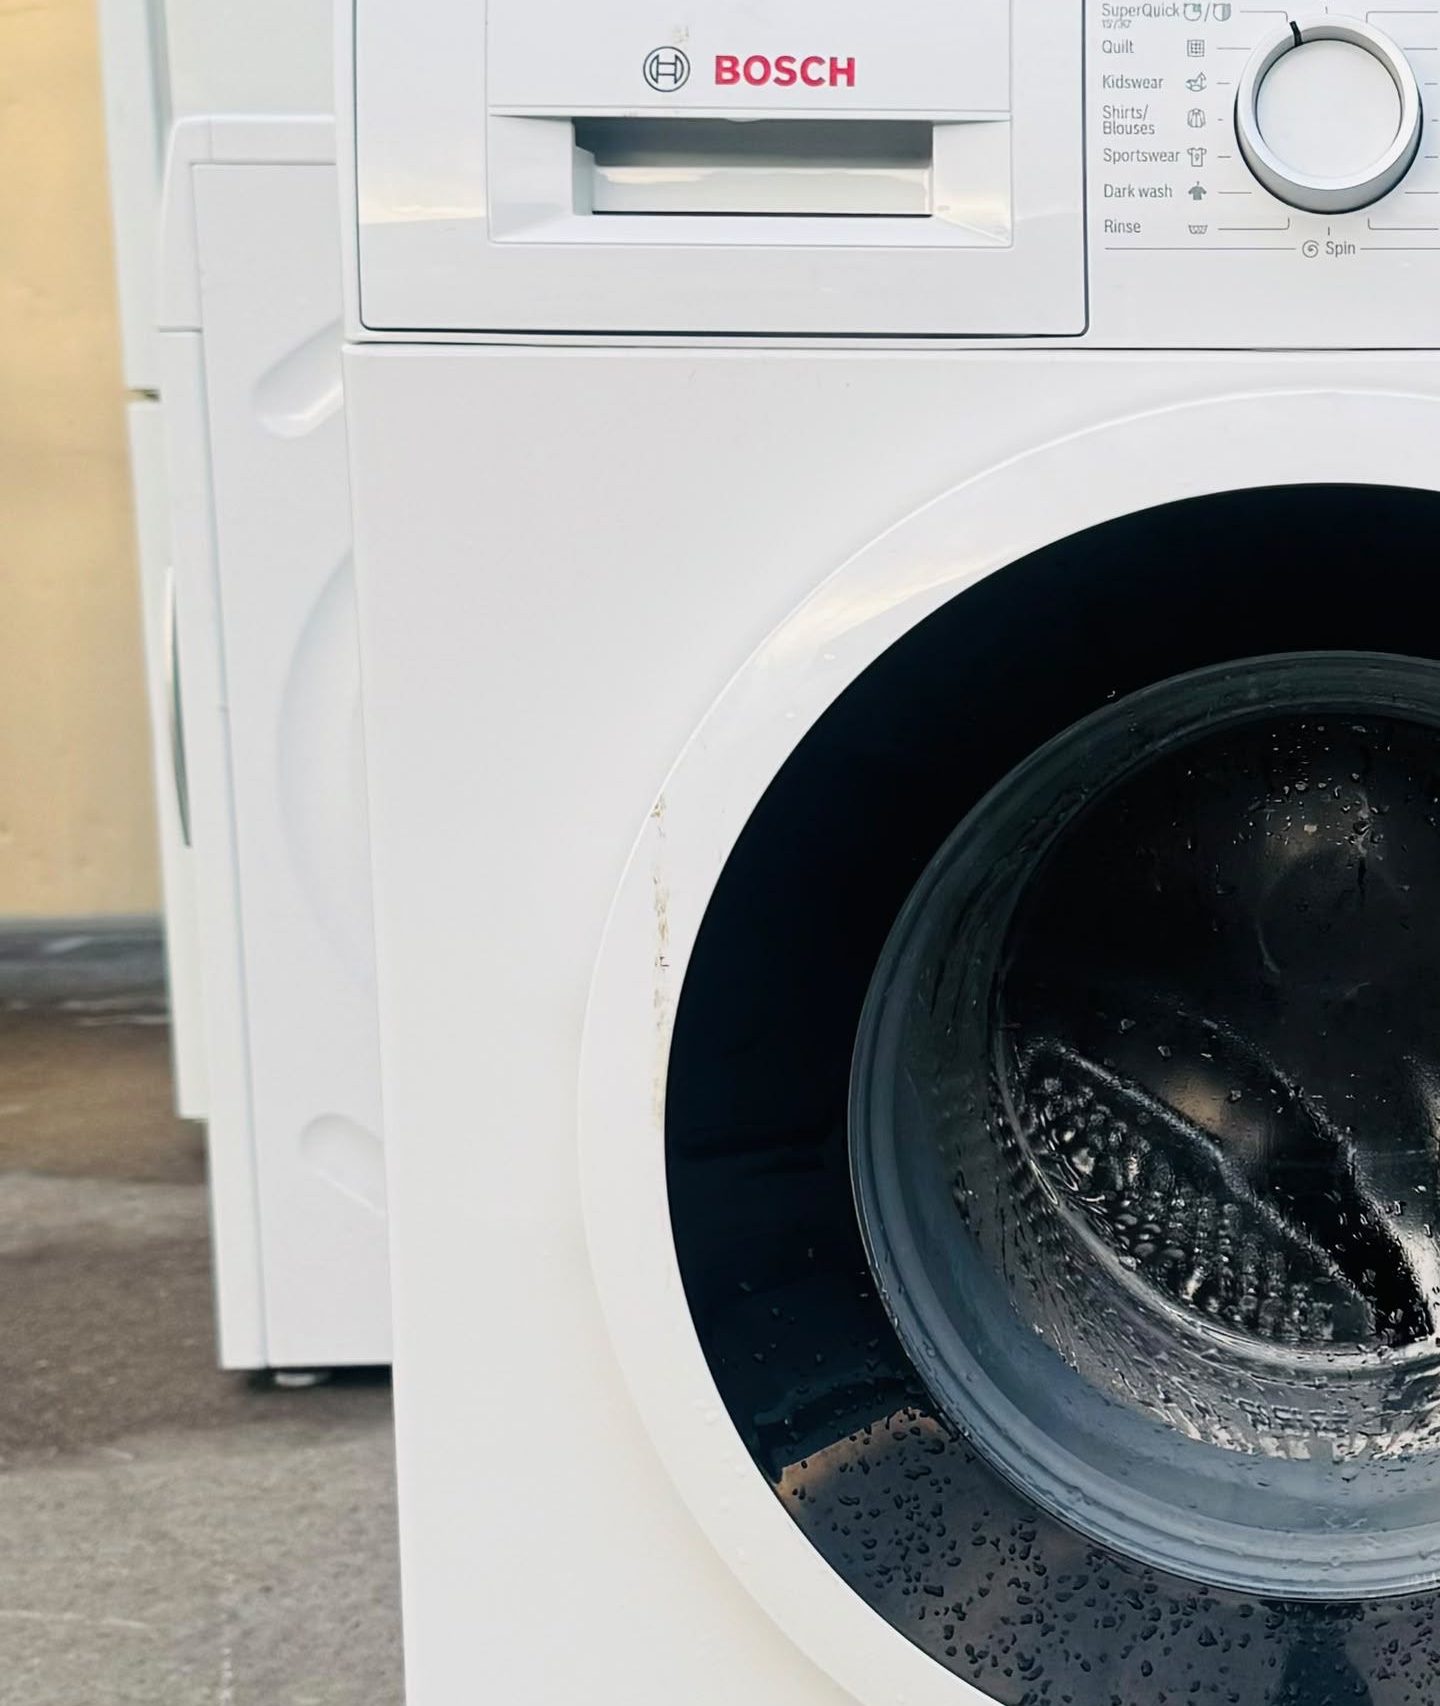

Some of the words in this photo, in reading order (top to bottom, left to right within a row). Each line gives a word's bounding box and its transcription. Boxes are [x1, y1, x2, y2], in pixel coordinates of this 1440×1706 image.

[1102, 3, 1180, 21] SuperQuick
[1102, 40, 1134, 54] Quilt
[714, 55, 856, 87] BOSCH
[1102, 74, 1164, 90] Kidswear
[1102, 104, 1149, 122] Shirts/
[1102, 120, 1155, 136] Blouses
[1103, 147, 1180, 166] Sportswear
[1104, 184, 1134, 199] Dark
[1137, 184, 1173, 199] wash
[1104, 219, 1142, 234] Rinse
[1325, 240, 1356, 257] Spin
